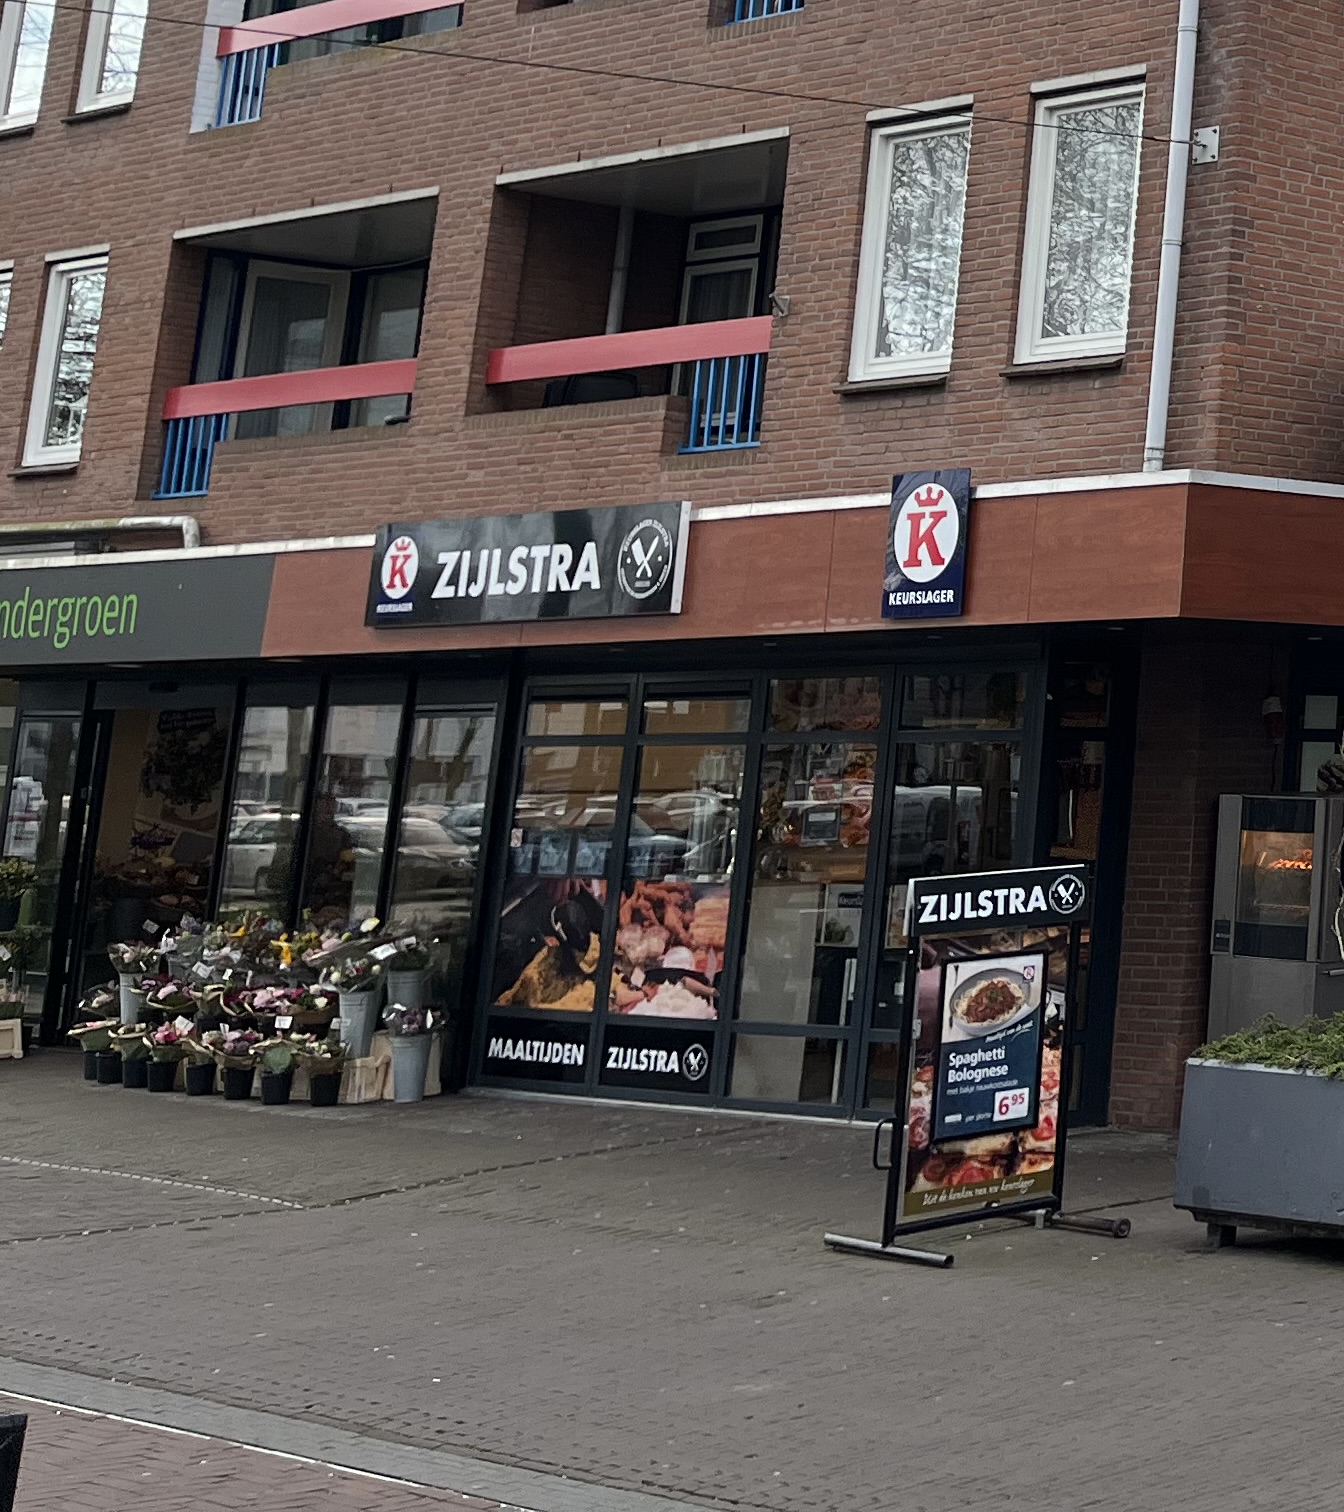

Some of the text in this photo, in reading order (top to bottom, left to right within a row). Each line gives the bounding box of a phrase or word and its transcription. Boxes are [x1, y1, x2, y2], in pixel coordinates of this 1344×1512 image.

[903, 511, 948, 568] K
[386, 554, 411, 589] K
[431, 542, 601, 599] ZIJLSTRA
[888, 589, 954, 605] KEURSLAGER
[0, 586, 137, 649] ndergroen
[918, 885, 1048, 924] ZIJLSTRA
[488, 1037, 585, 1066] MAALTIJDEN
[605, 1046, 680, 1073] ZIJLSTRA
[948, 1045, 1005, 1068] Spaghetti
[948, 1065, 1009, 1083] Bolognese
